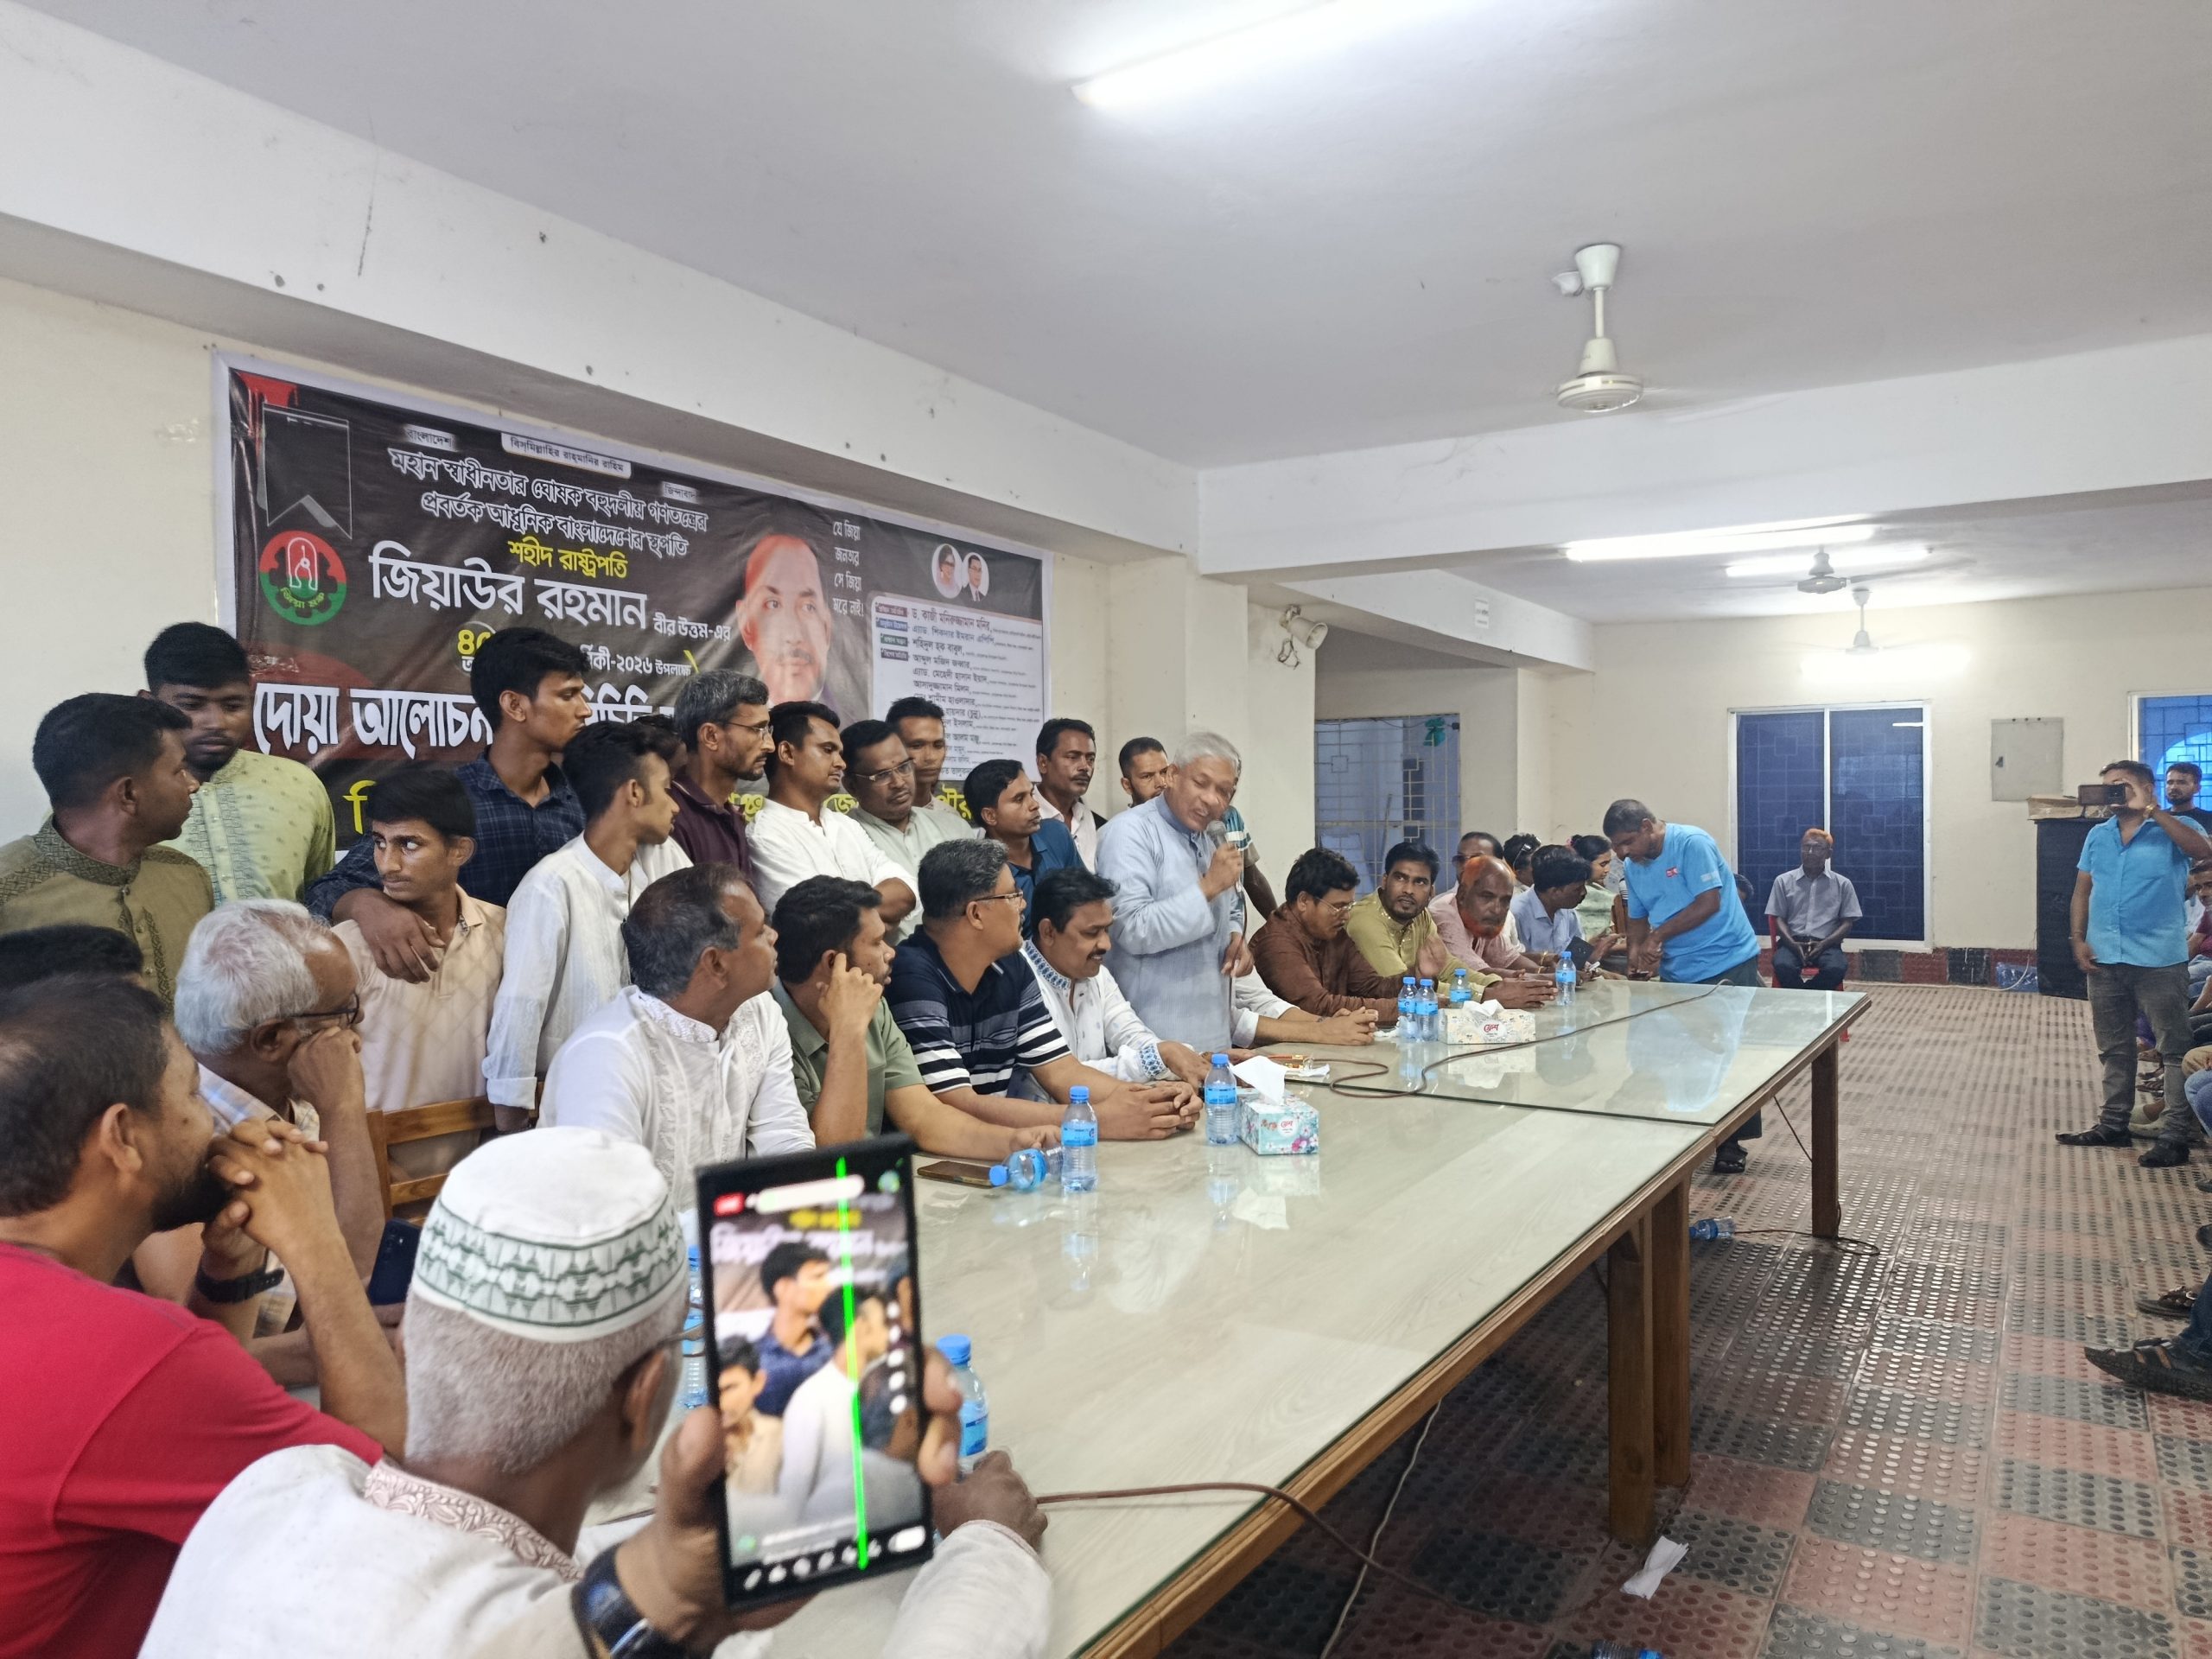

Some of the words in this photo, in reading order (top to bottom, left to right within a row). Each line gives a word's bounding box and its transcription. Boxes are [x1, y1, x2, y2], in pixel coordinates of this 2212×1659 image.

[406, 428, 453, 448] বাংলাদেশ
[388, 448, 442, 480] মহান
[442, 457, 529, 497] স্বাধীনতার
[531, 477, 584, 506] ঘোষক
[584, 490, 646, 520] বহুদলীয়
[648, 500, 709, 532] গণতন্ত্রের
[421, 491, 486, 523] প্রবর্তক
[486, 503, 555, 534] আধুনিক
[556, 516, 645, 551] বাংলাদেশের
[645, 531, 689, 558] স্থপতি
[833, 521, 843, 537] যে
[844, 519, 861, 541] জিয়া
[507, 536, 553, 568] শহীদ
[558, 548, 628, 578] রাষ্ট্রপতি
[368, 540, 525, 614] জিয়াউর
[534, 579, 648, 629] রহমান
[834, 573, 844, 588] সে
[846, 571, 862, 592] জিয়া
[832, 598, 848, 615] মরে
[921, 607, 937, 621] কাজী
[653, 612, 676, 637] বীর
[253, 683, 340, 755] দোয়া
